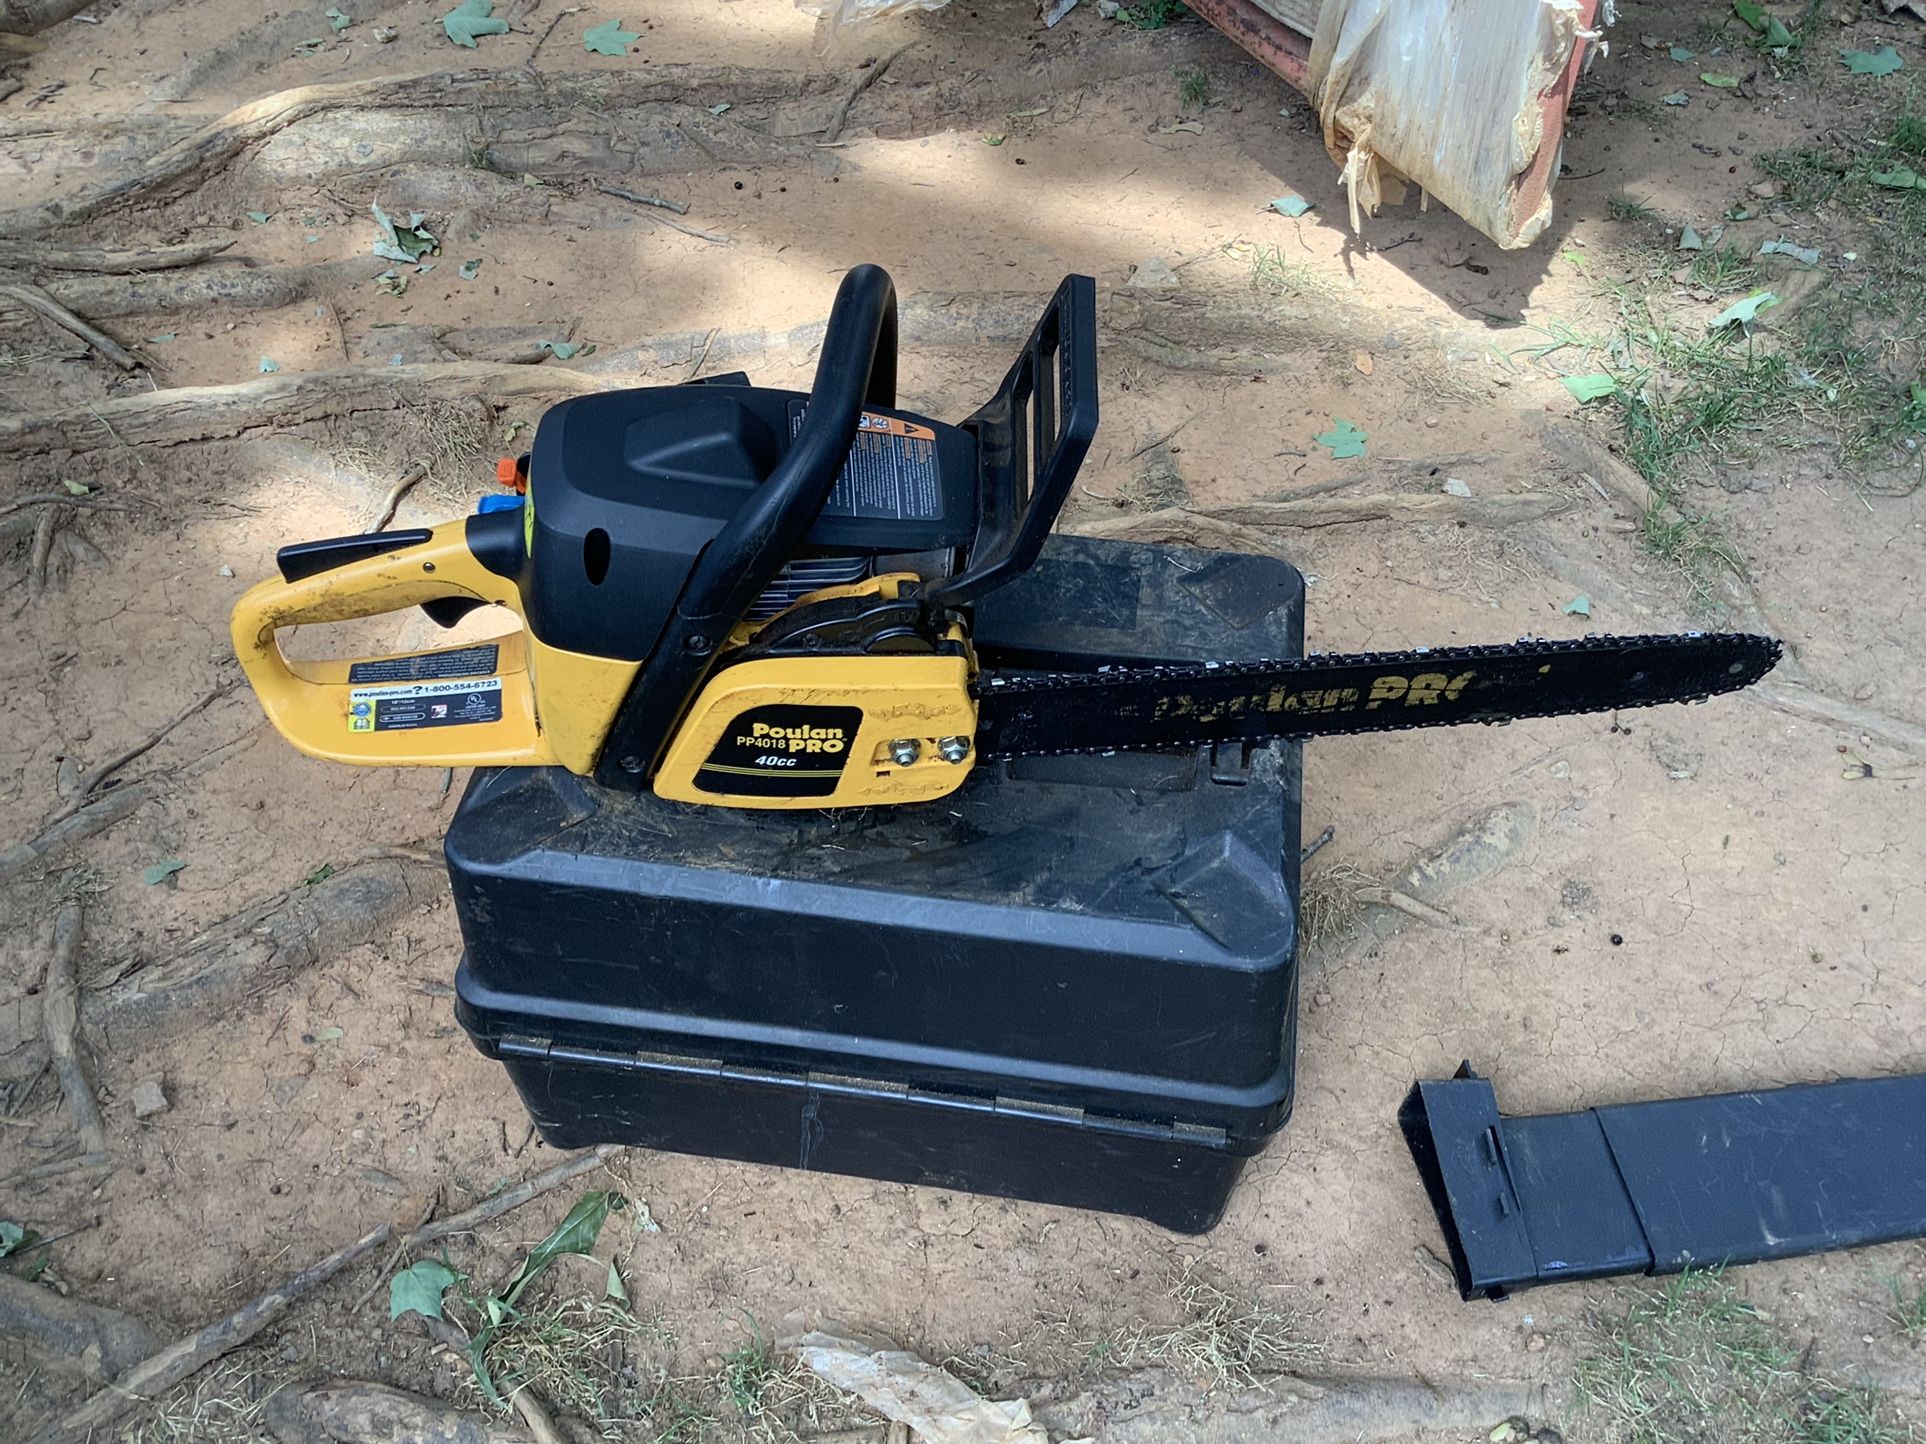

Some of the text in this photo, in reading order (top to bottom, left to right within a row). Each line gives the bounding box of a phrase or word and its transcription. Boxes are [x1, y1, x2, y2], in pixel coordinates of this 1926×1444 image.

[424, 680, 498, 694] 1-800-554-6723
[752, 722, 843, 739] Poulan
[736, 736, 844, 753] PP4018 PRO
[754, 755, 797, 767] 40cc
